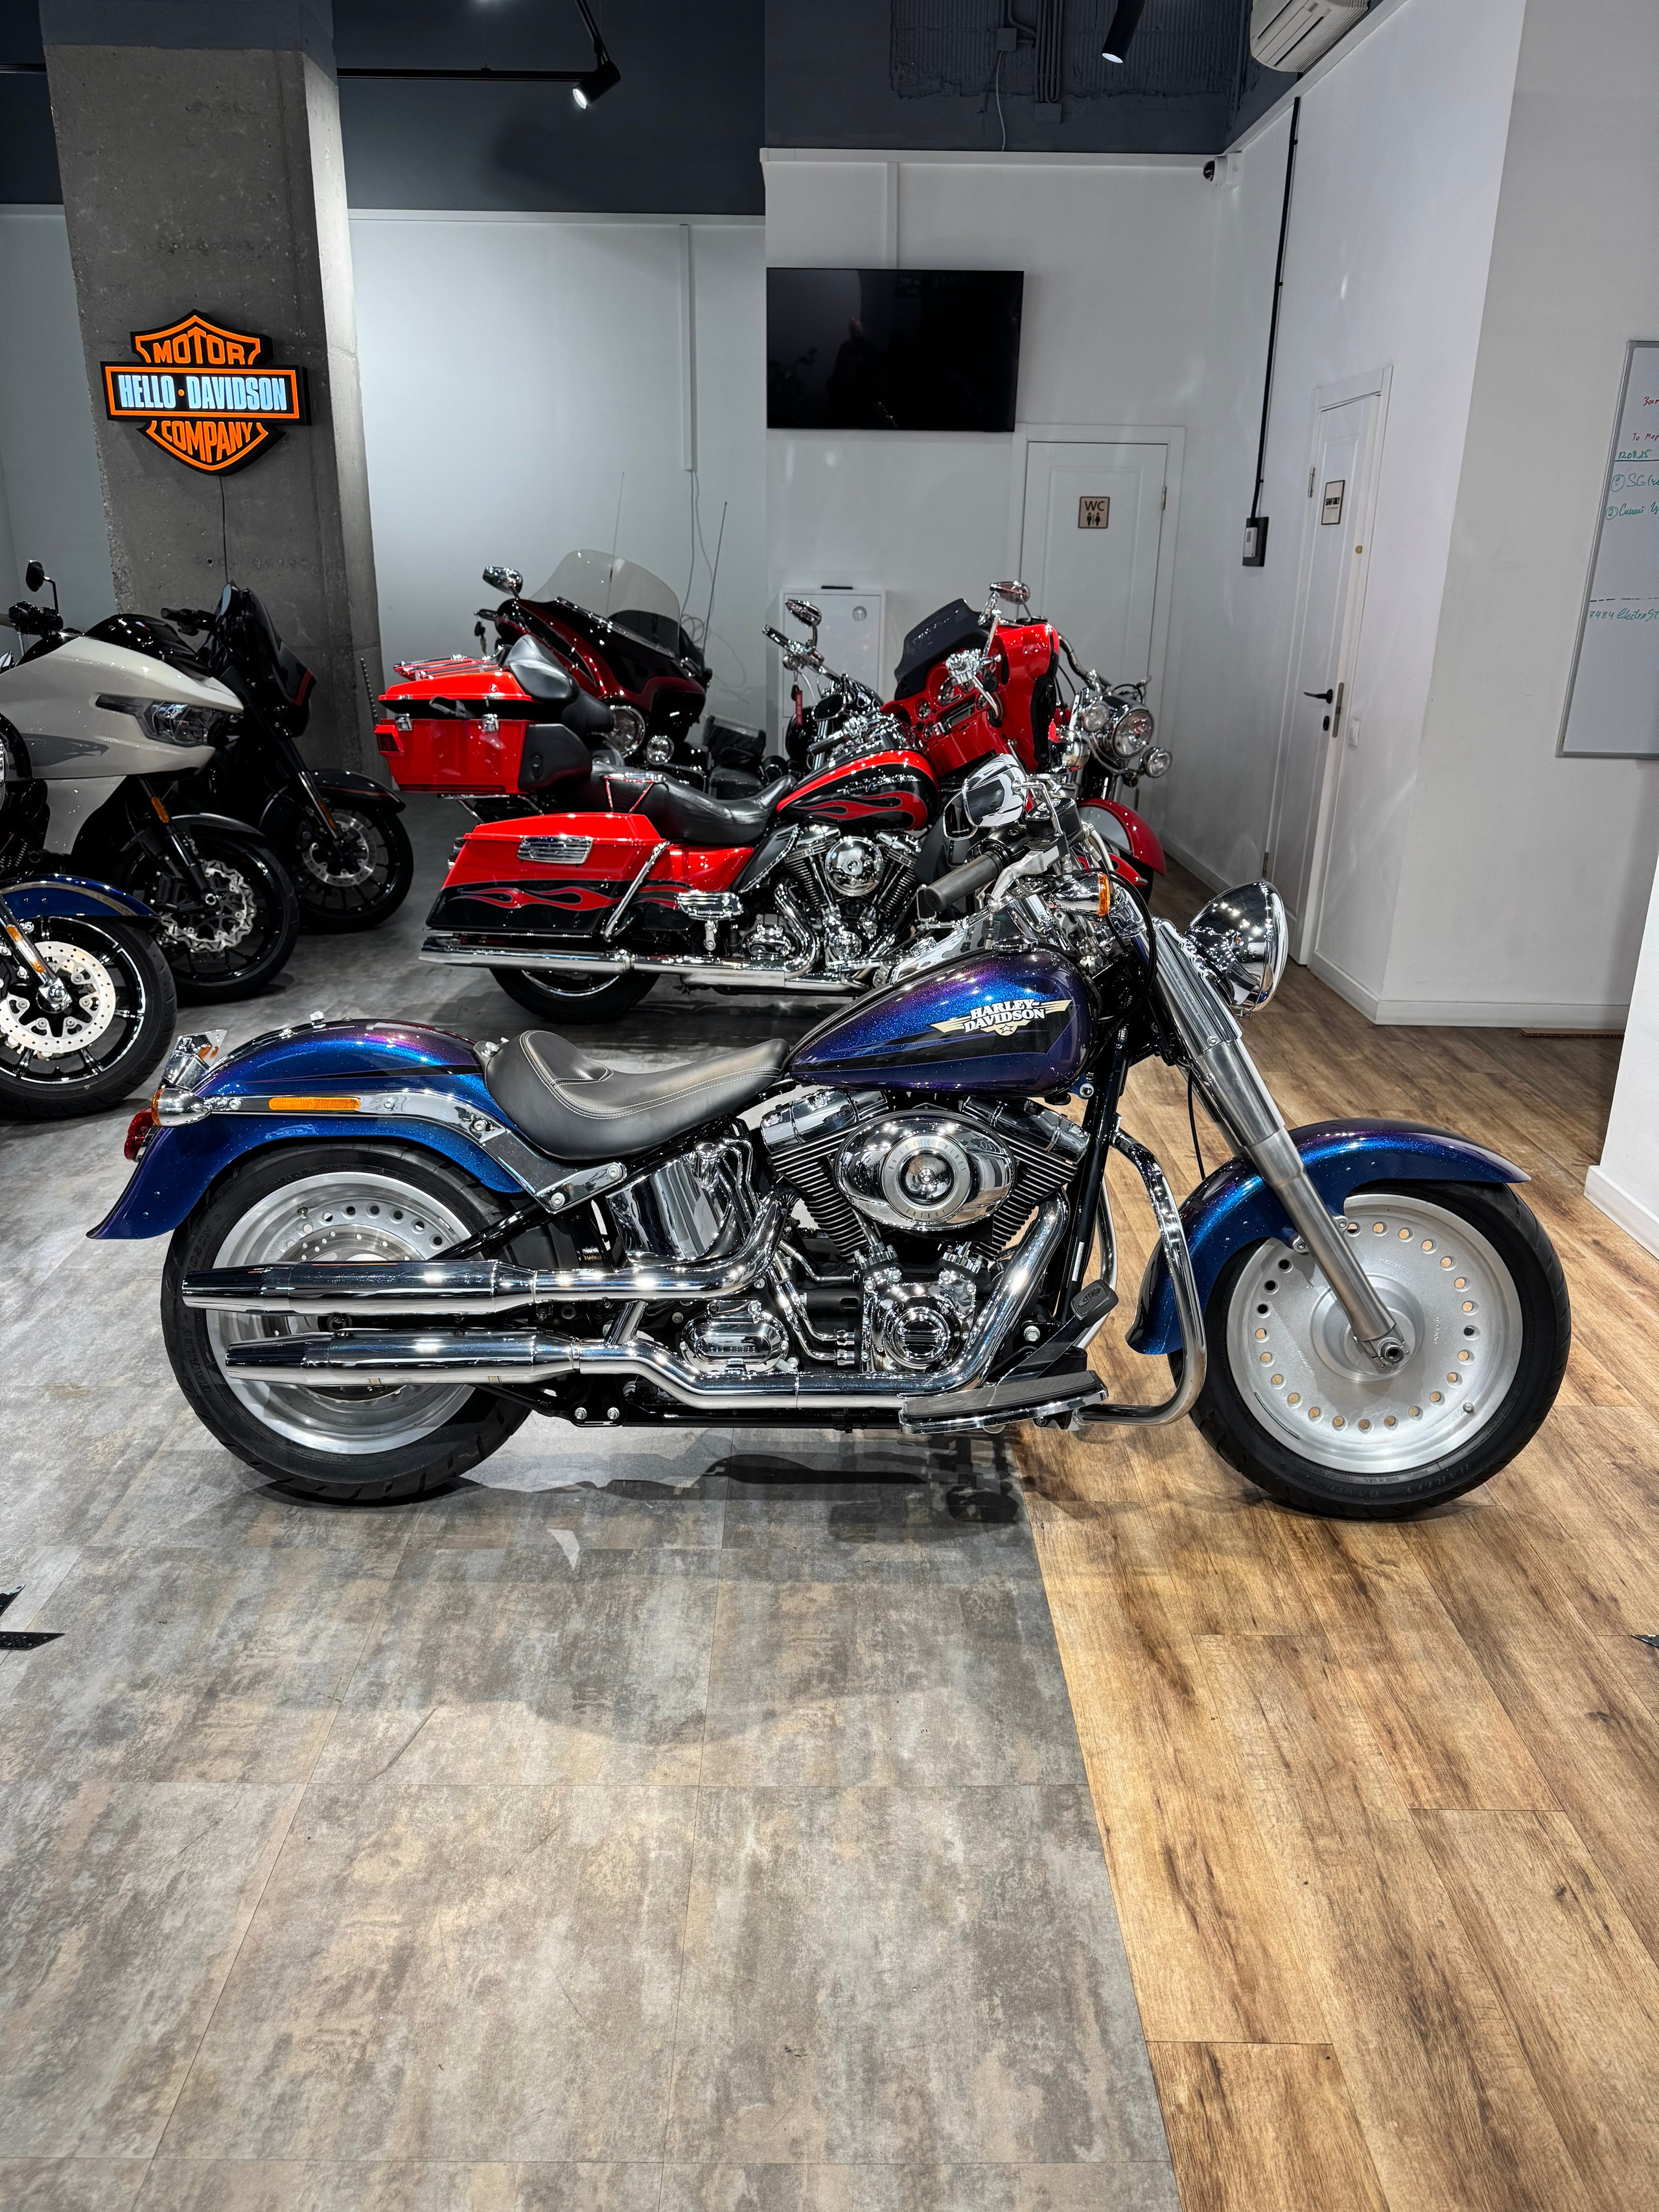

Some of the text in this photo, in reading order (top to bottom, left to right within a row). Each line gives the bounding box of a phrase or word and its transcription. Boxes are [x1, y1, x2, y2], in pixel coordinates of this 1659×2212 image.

[153, 327, 245, 364] MOTOR
[118, 375, 287, 410] HELLO DAVIDSON
[161, 420, 253, 463] COMPANY
[1085, 500, 1105, 511] WC
[963, 1008, 1046, 1033] DAVIDSON
